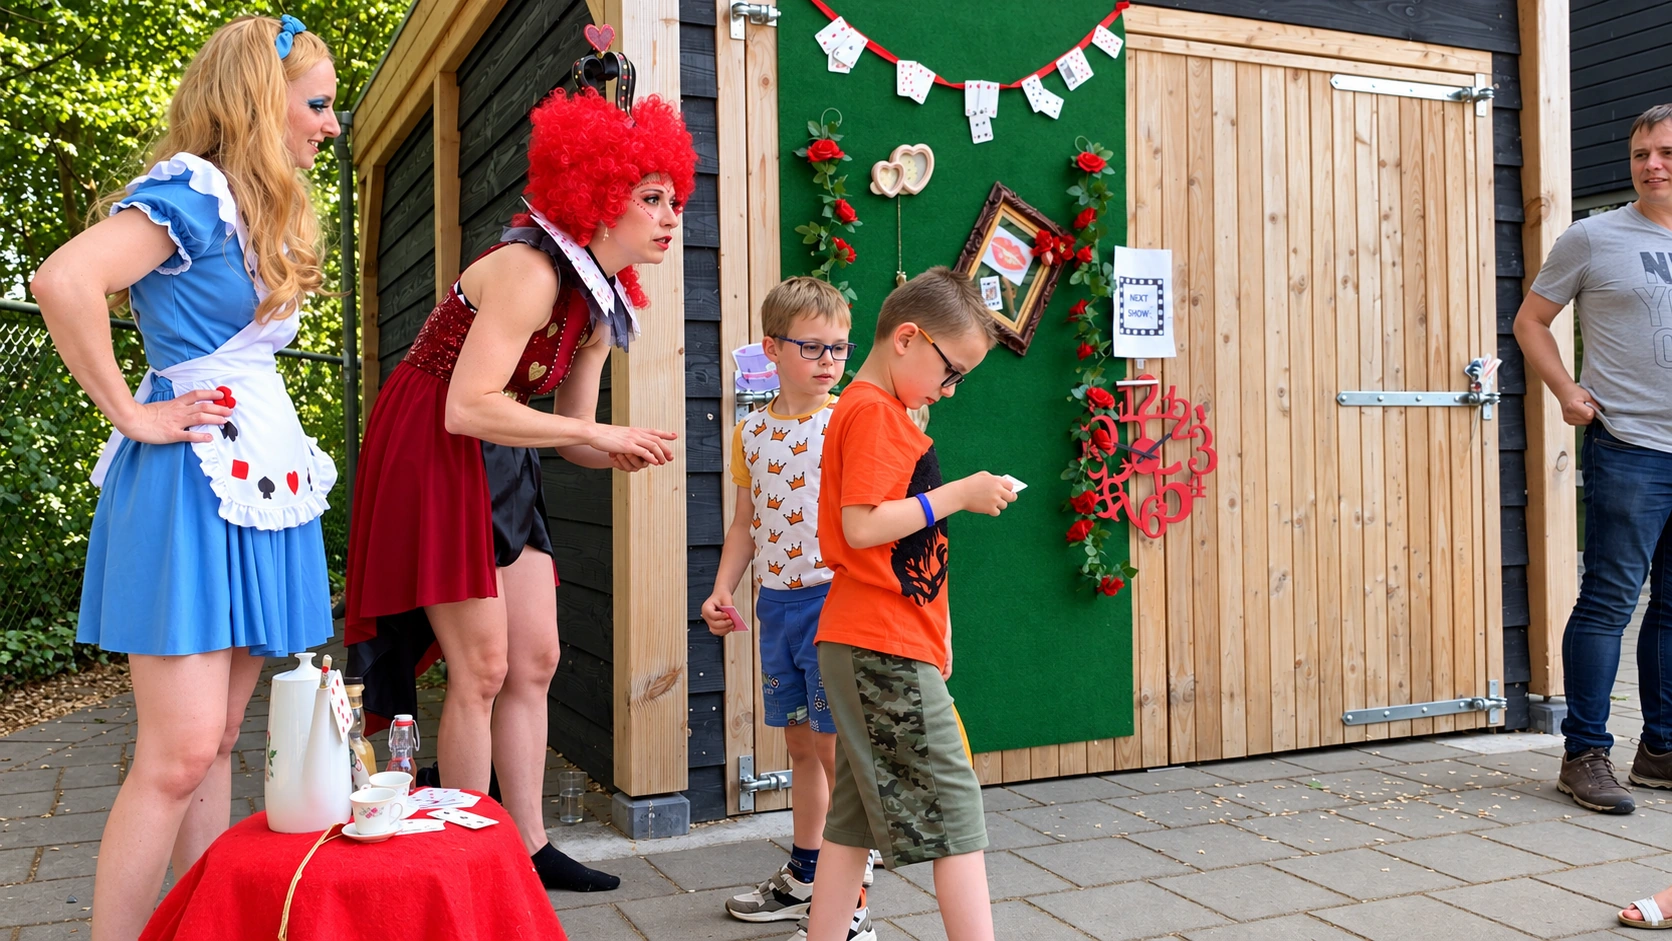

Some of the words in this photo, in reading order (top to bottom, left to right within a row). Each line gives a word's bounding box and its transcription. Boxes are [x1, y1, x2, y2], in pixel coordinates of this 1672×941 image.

[1129, 294, 1148, 302] NEXT
[1187, 424, 1218, 475] 3
[1153, 460, 1193, 523] 5
[1140, 495, 1167, 538] 6
